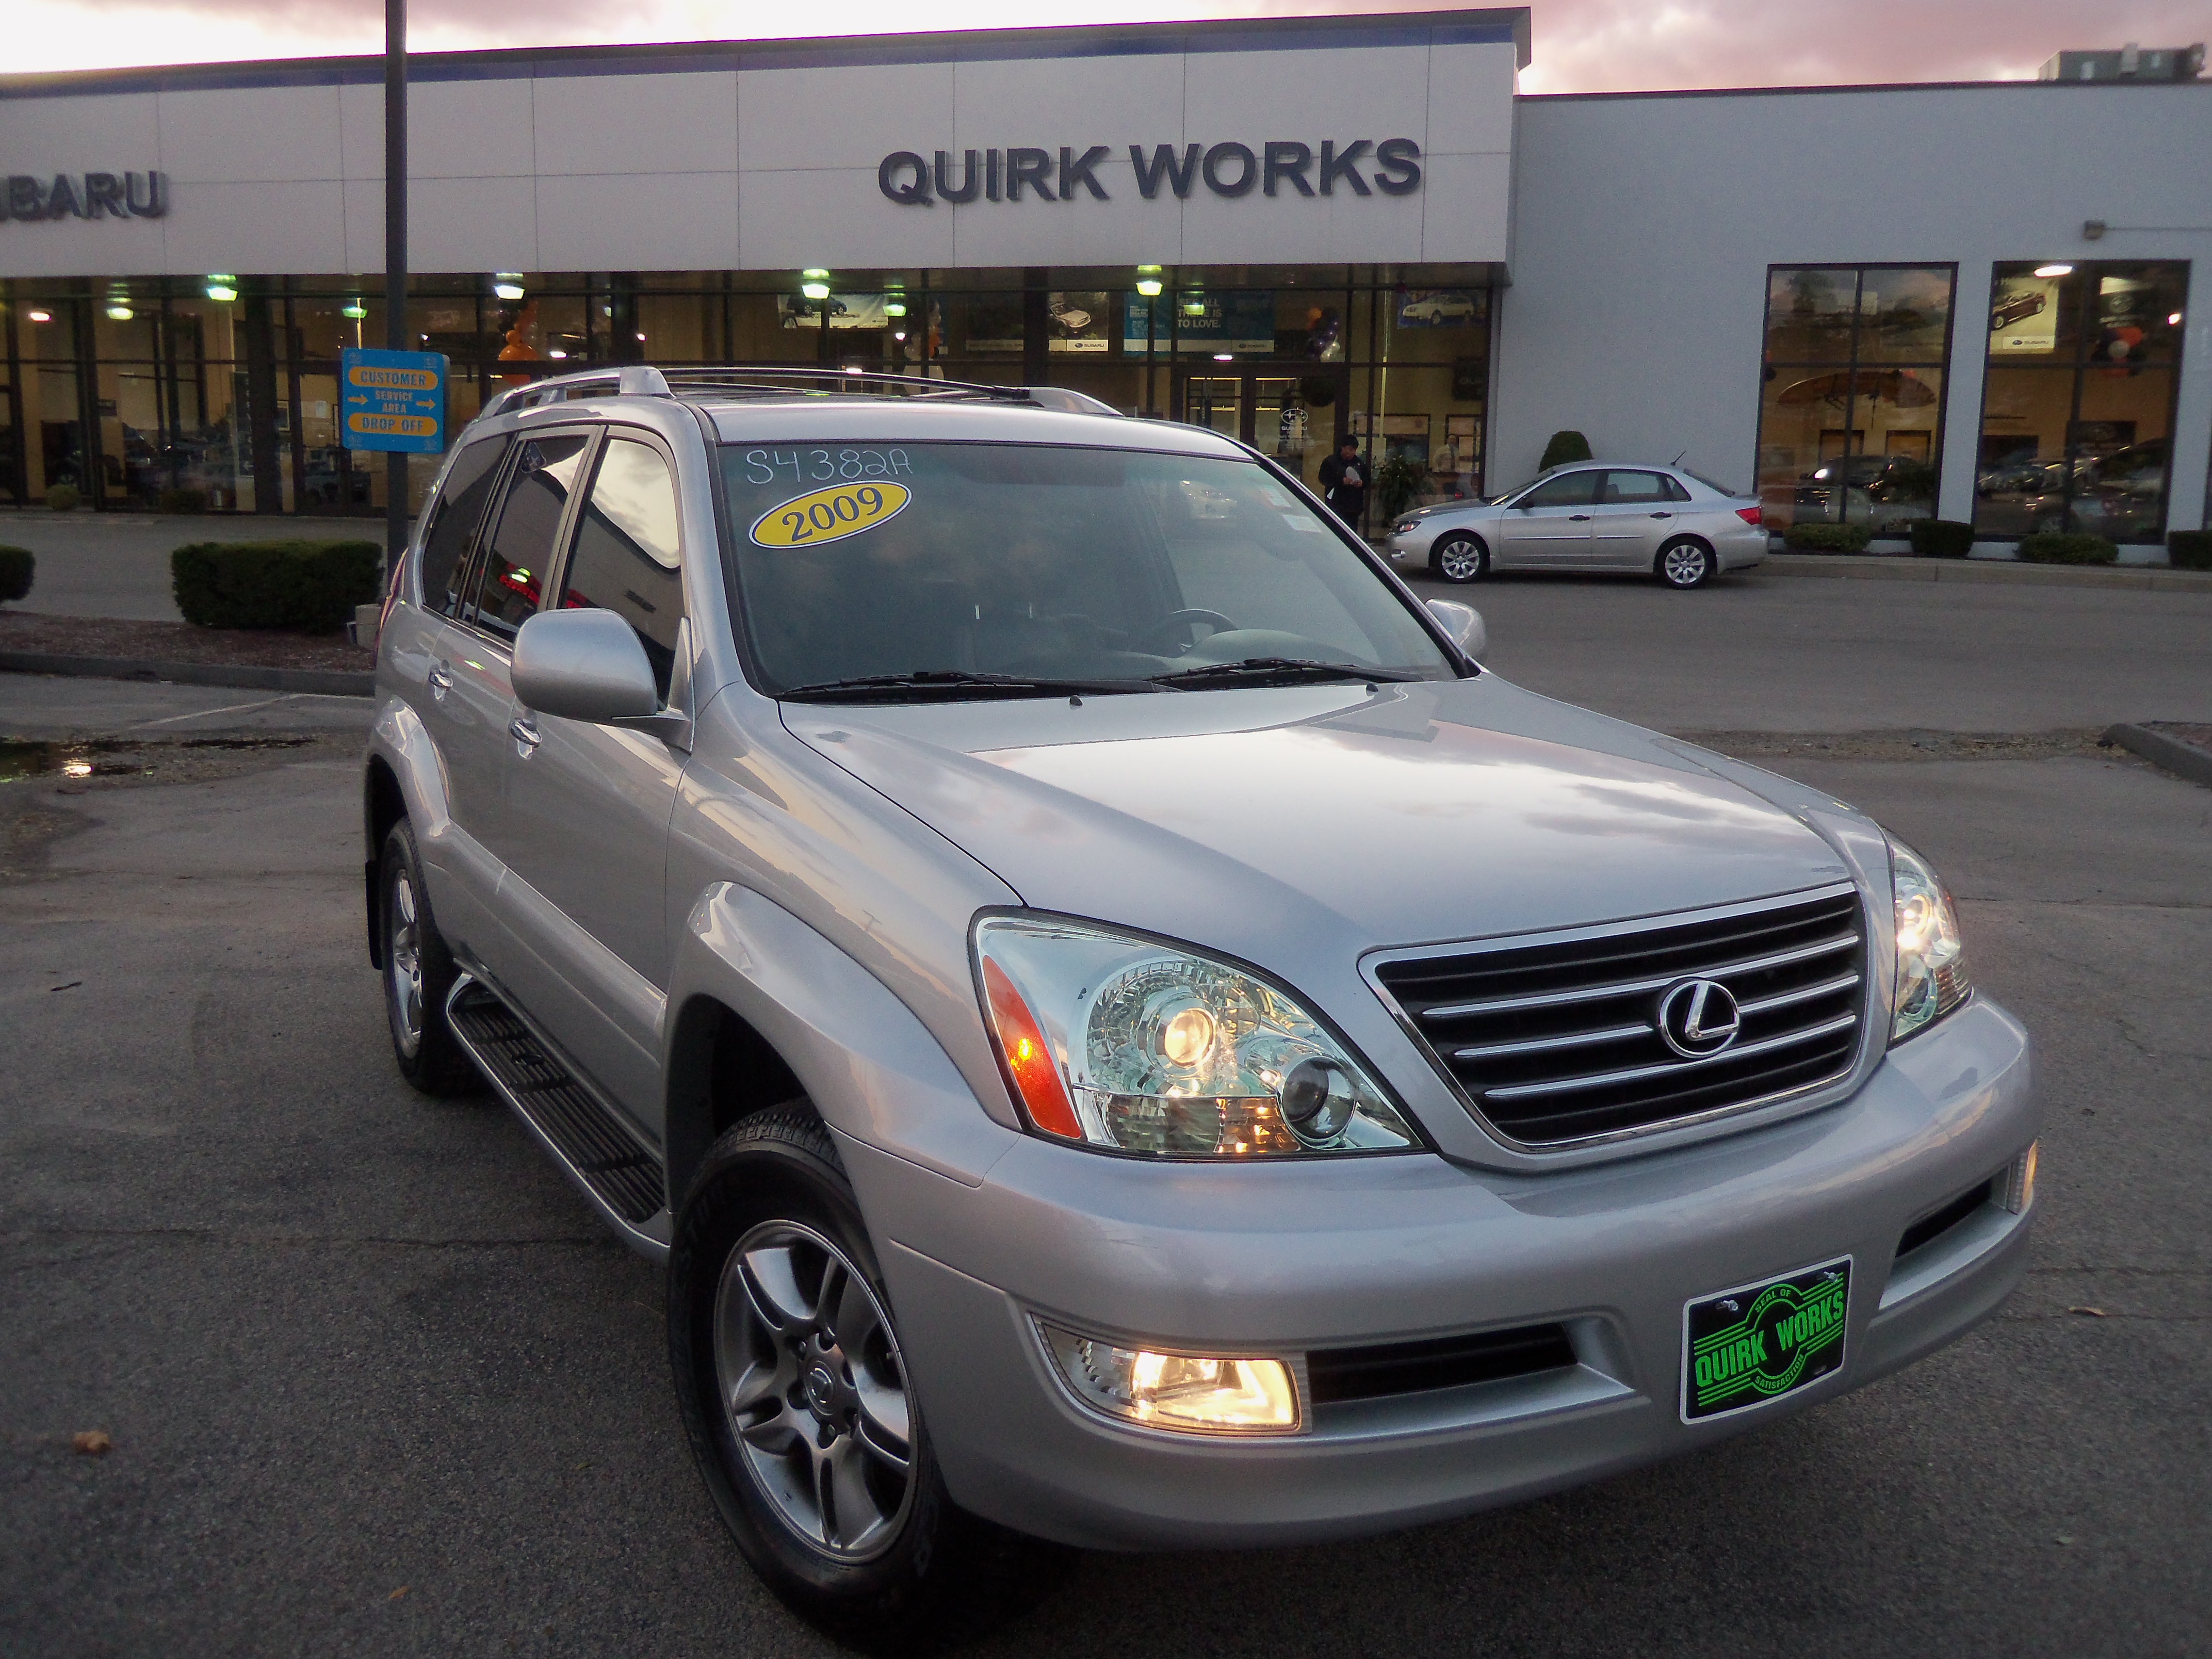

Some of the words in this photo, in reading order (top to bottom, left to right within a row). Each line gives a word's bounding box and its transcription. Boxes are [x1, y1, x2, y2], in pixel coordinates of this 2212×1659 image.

[878, 146, 1109, 206] QUIRK
[1128, 138, 1421, 198] WORKS
[0, 171, 168, 221] BARU
[1202, 298, 1220, 306] ALL
[1213, 309, 1222, 317] IS
[1178, 319, 1190, 328] TO
[1193, 319, 1221, 328] LOVE.
[361, 371, 426, 386] CUSTOMER
[375, 391, 413, 401] SERVICE
[382, 403, 406, 413] AREA
[363, 417, 395, 430] DROP
[401, 419, 424, 432] OFF
[746, 448, 913, 484] S4382A
[782, 487, 883, 542] 2009
[1755, 1289, 1777, 1313] SEAL
[1780, 1289, 1791, 1297] OF
[1695, 1330, 1767, 1388] QUIRK
[1776, 1290, 1844, 1351] WORKS
[1755, 1353, 1804, 1389] SATISFACTION
